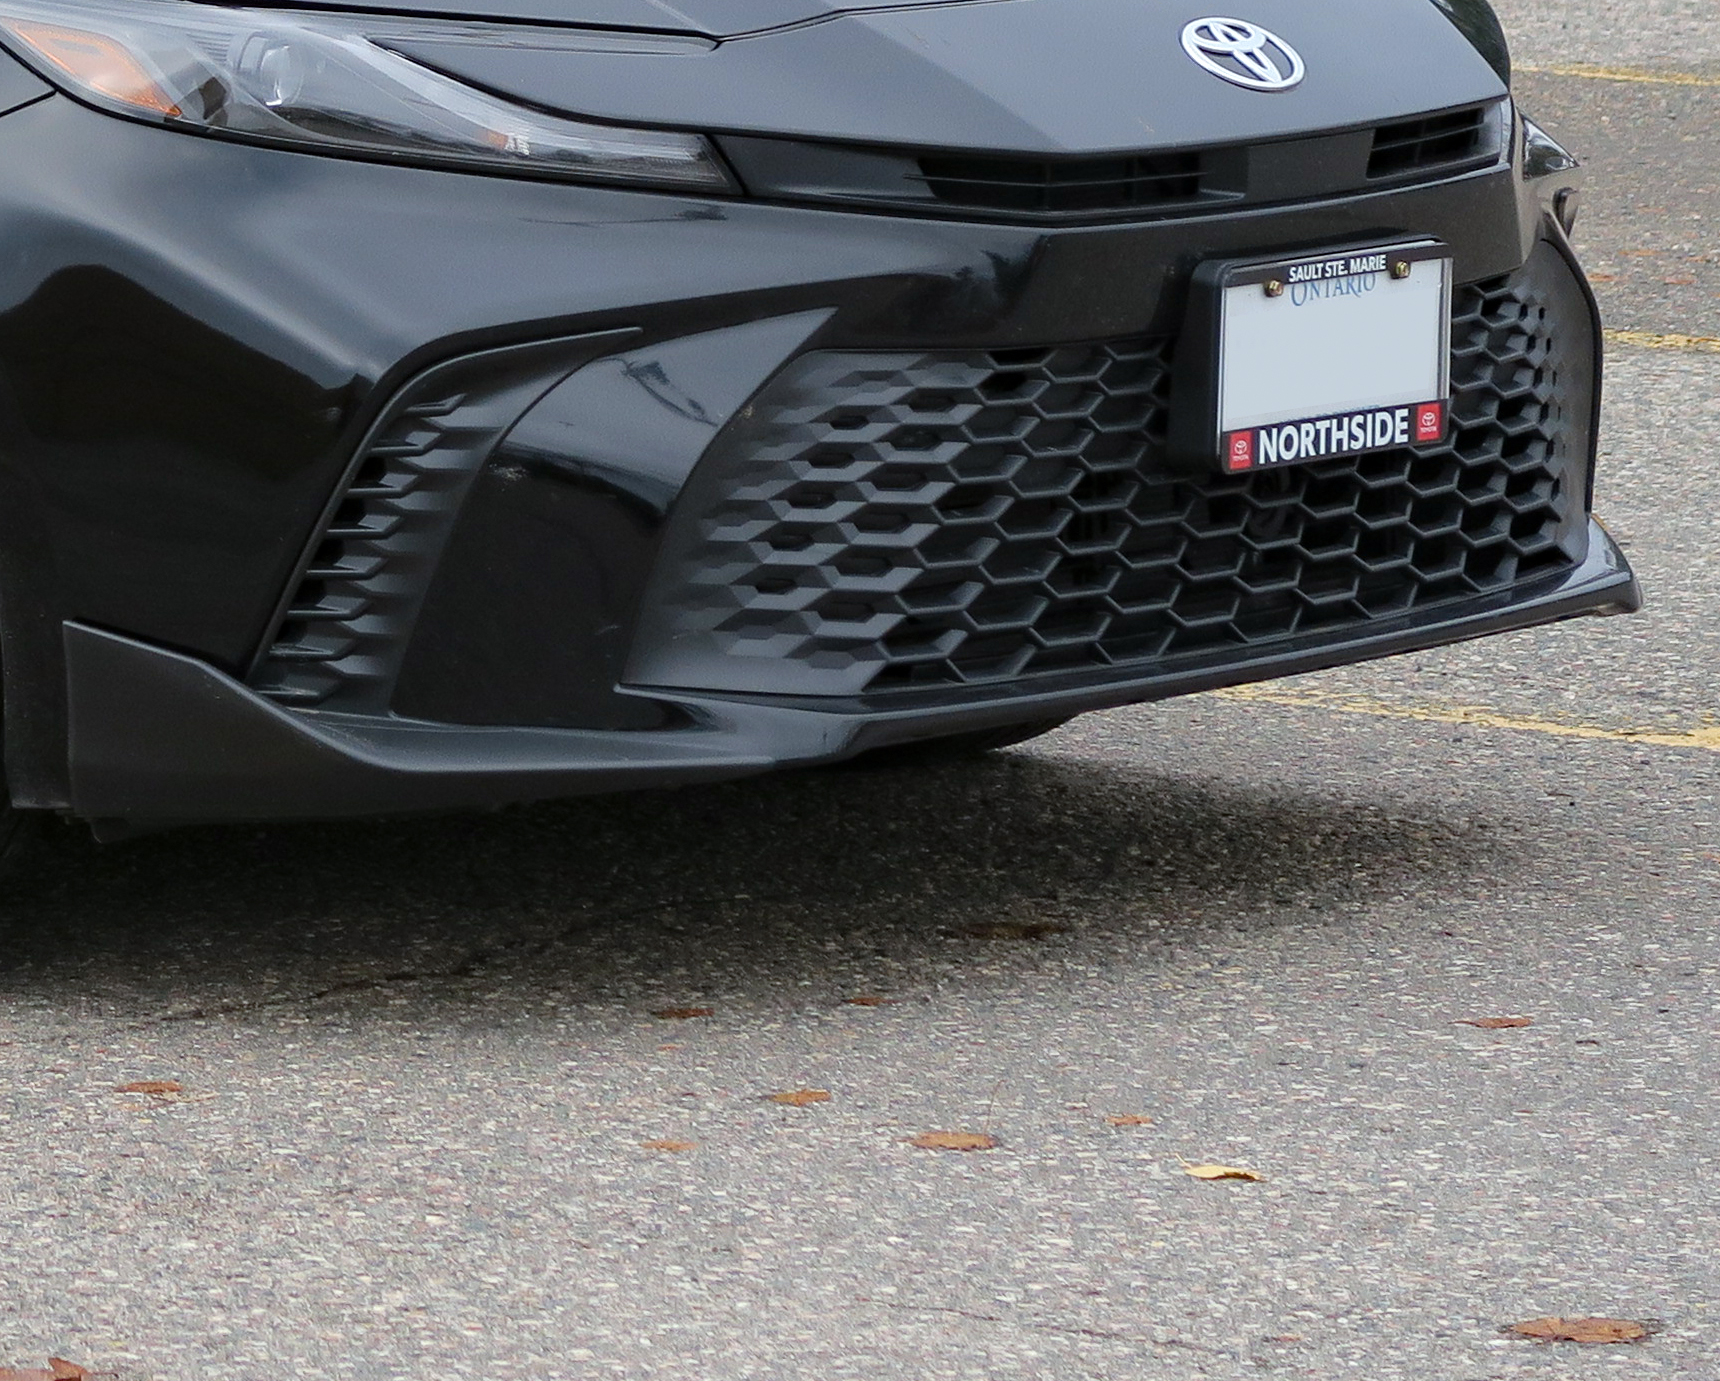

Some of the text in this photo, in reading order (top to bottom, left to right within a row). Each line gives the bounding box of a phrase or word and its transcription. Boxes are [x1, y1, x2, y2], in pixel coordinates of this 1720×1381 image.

[1288, 254, 1387, 283] SAULT STE. MARIE
[1290, 273, 1376, 307] ONTARIO
[1258, 408, 1409, 465] NORTHSIDE
